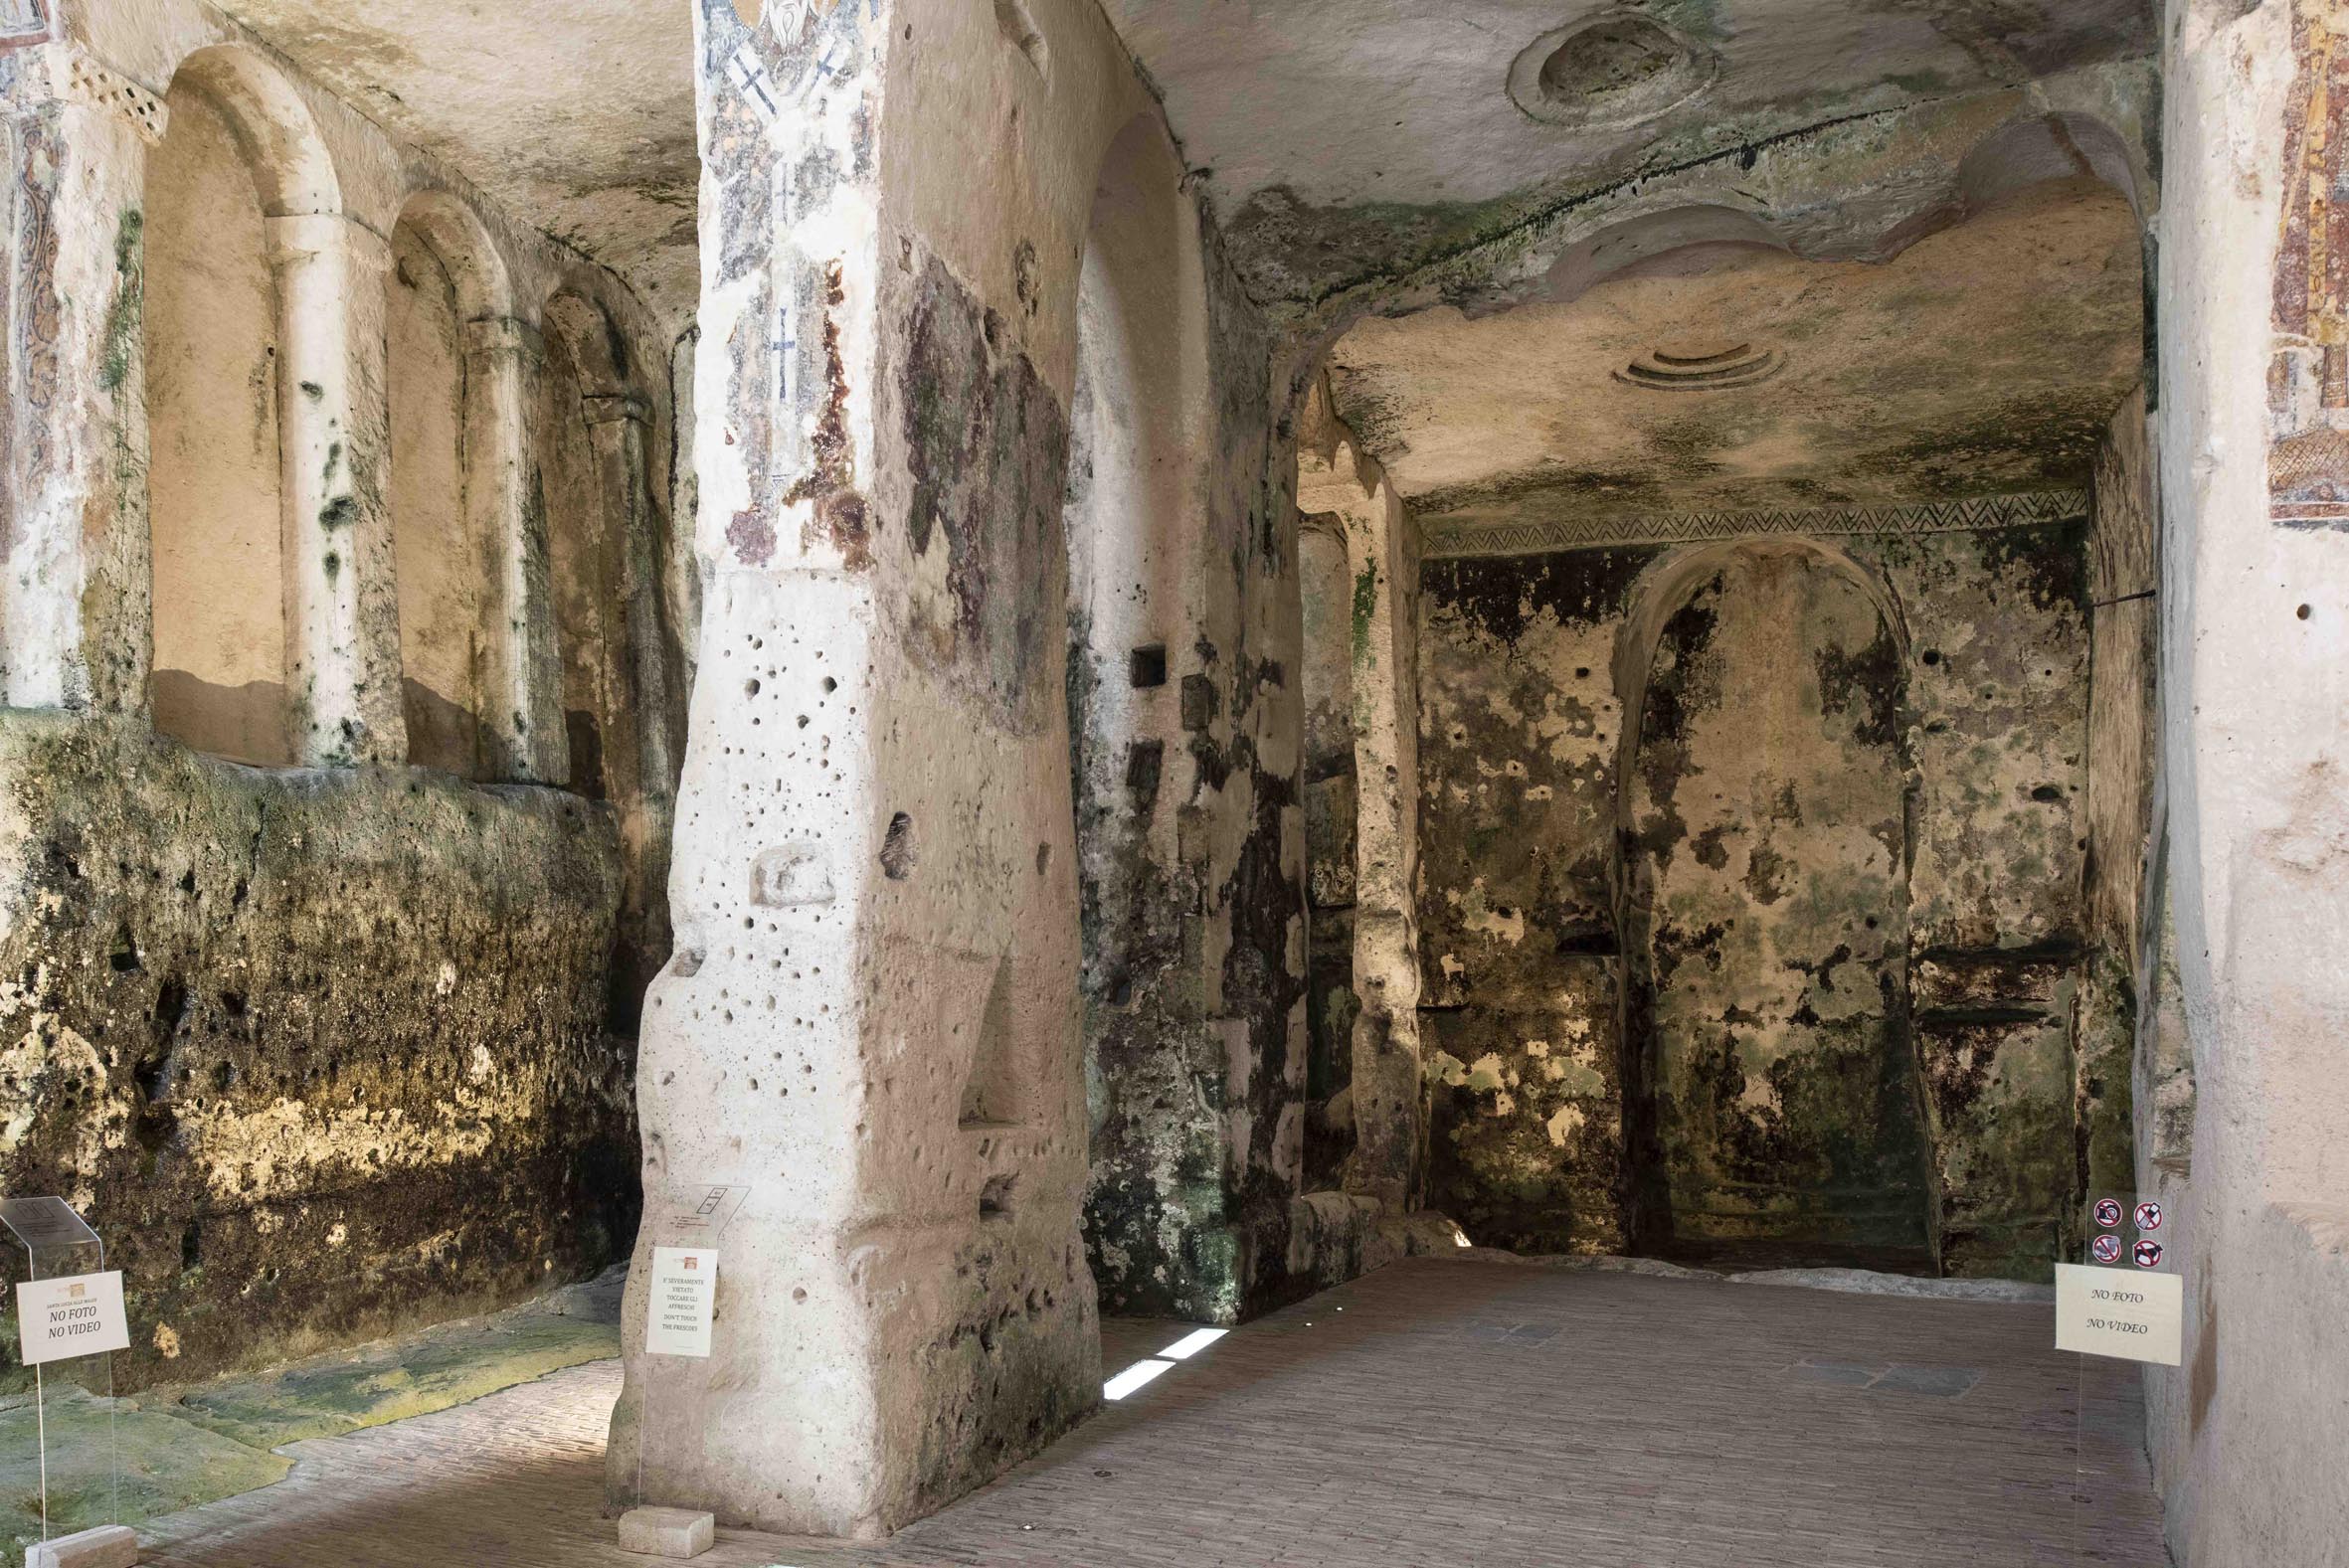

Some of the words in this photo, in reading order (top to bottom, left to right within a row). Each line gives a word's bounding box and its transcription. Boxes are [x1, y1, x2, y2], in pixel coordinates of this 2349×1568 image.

[2090, 1289, 2109, 1300] NO
[2111, 1291, 2144, 1304] FOTO
[50, 1310, 66, 1323] NO
[69, 1306, 96, 1320] FOTO
[48, 1326, 65, 1339] NO
[68, 1320, 101, 1335] VIDEO
[2085, 1317, 2105, 1329] NO
[2106, 1320, 2148, 1334] VIDEO
